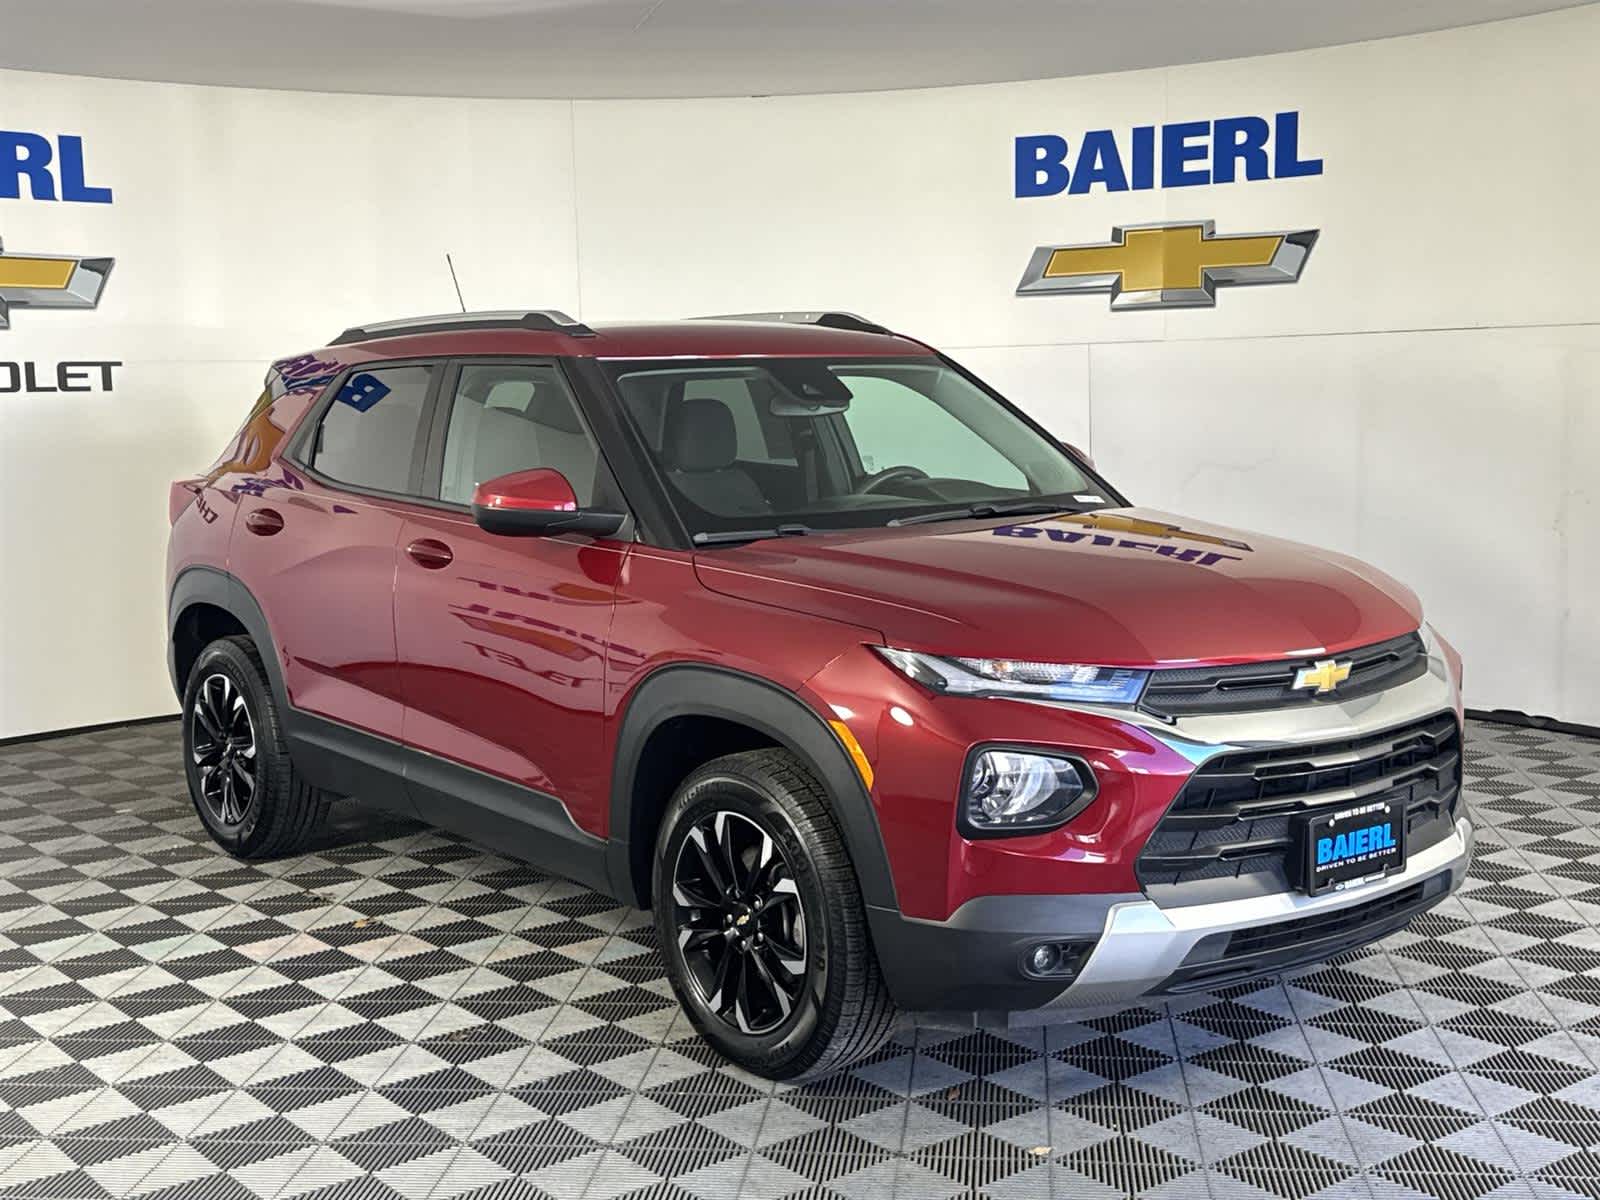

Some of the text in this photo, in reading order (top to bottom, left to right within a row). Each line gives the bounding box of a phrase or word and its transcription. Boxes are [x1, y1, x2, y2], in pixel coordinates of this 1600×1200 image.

[1014, 110, 1324, 199] BAIERL
[1316, 847, 1397, 873] DRIVEN TO BE BETTER
[1317, 823, 1396, 865] BAIERL
